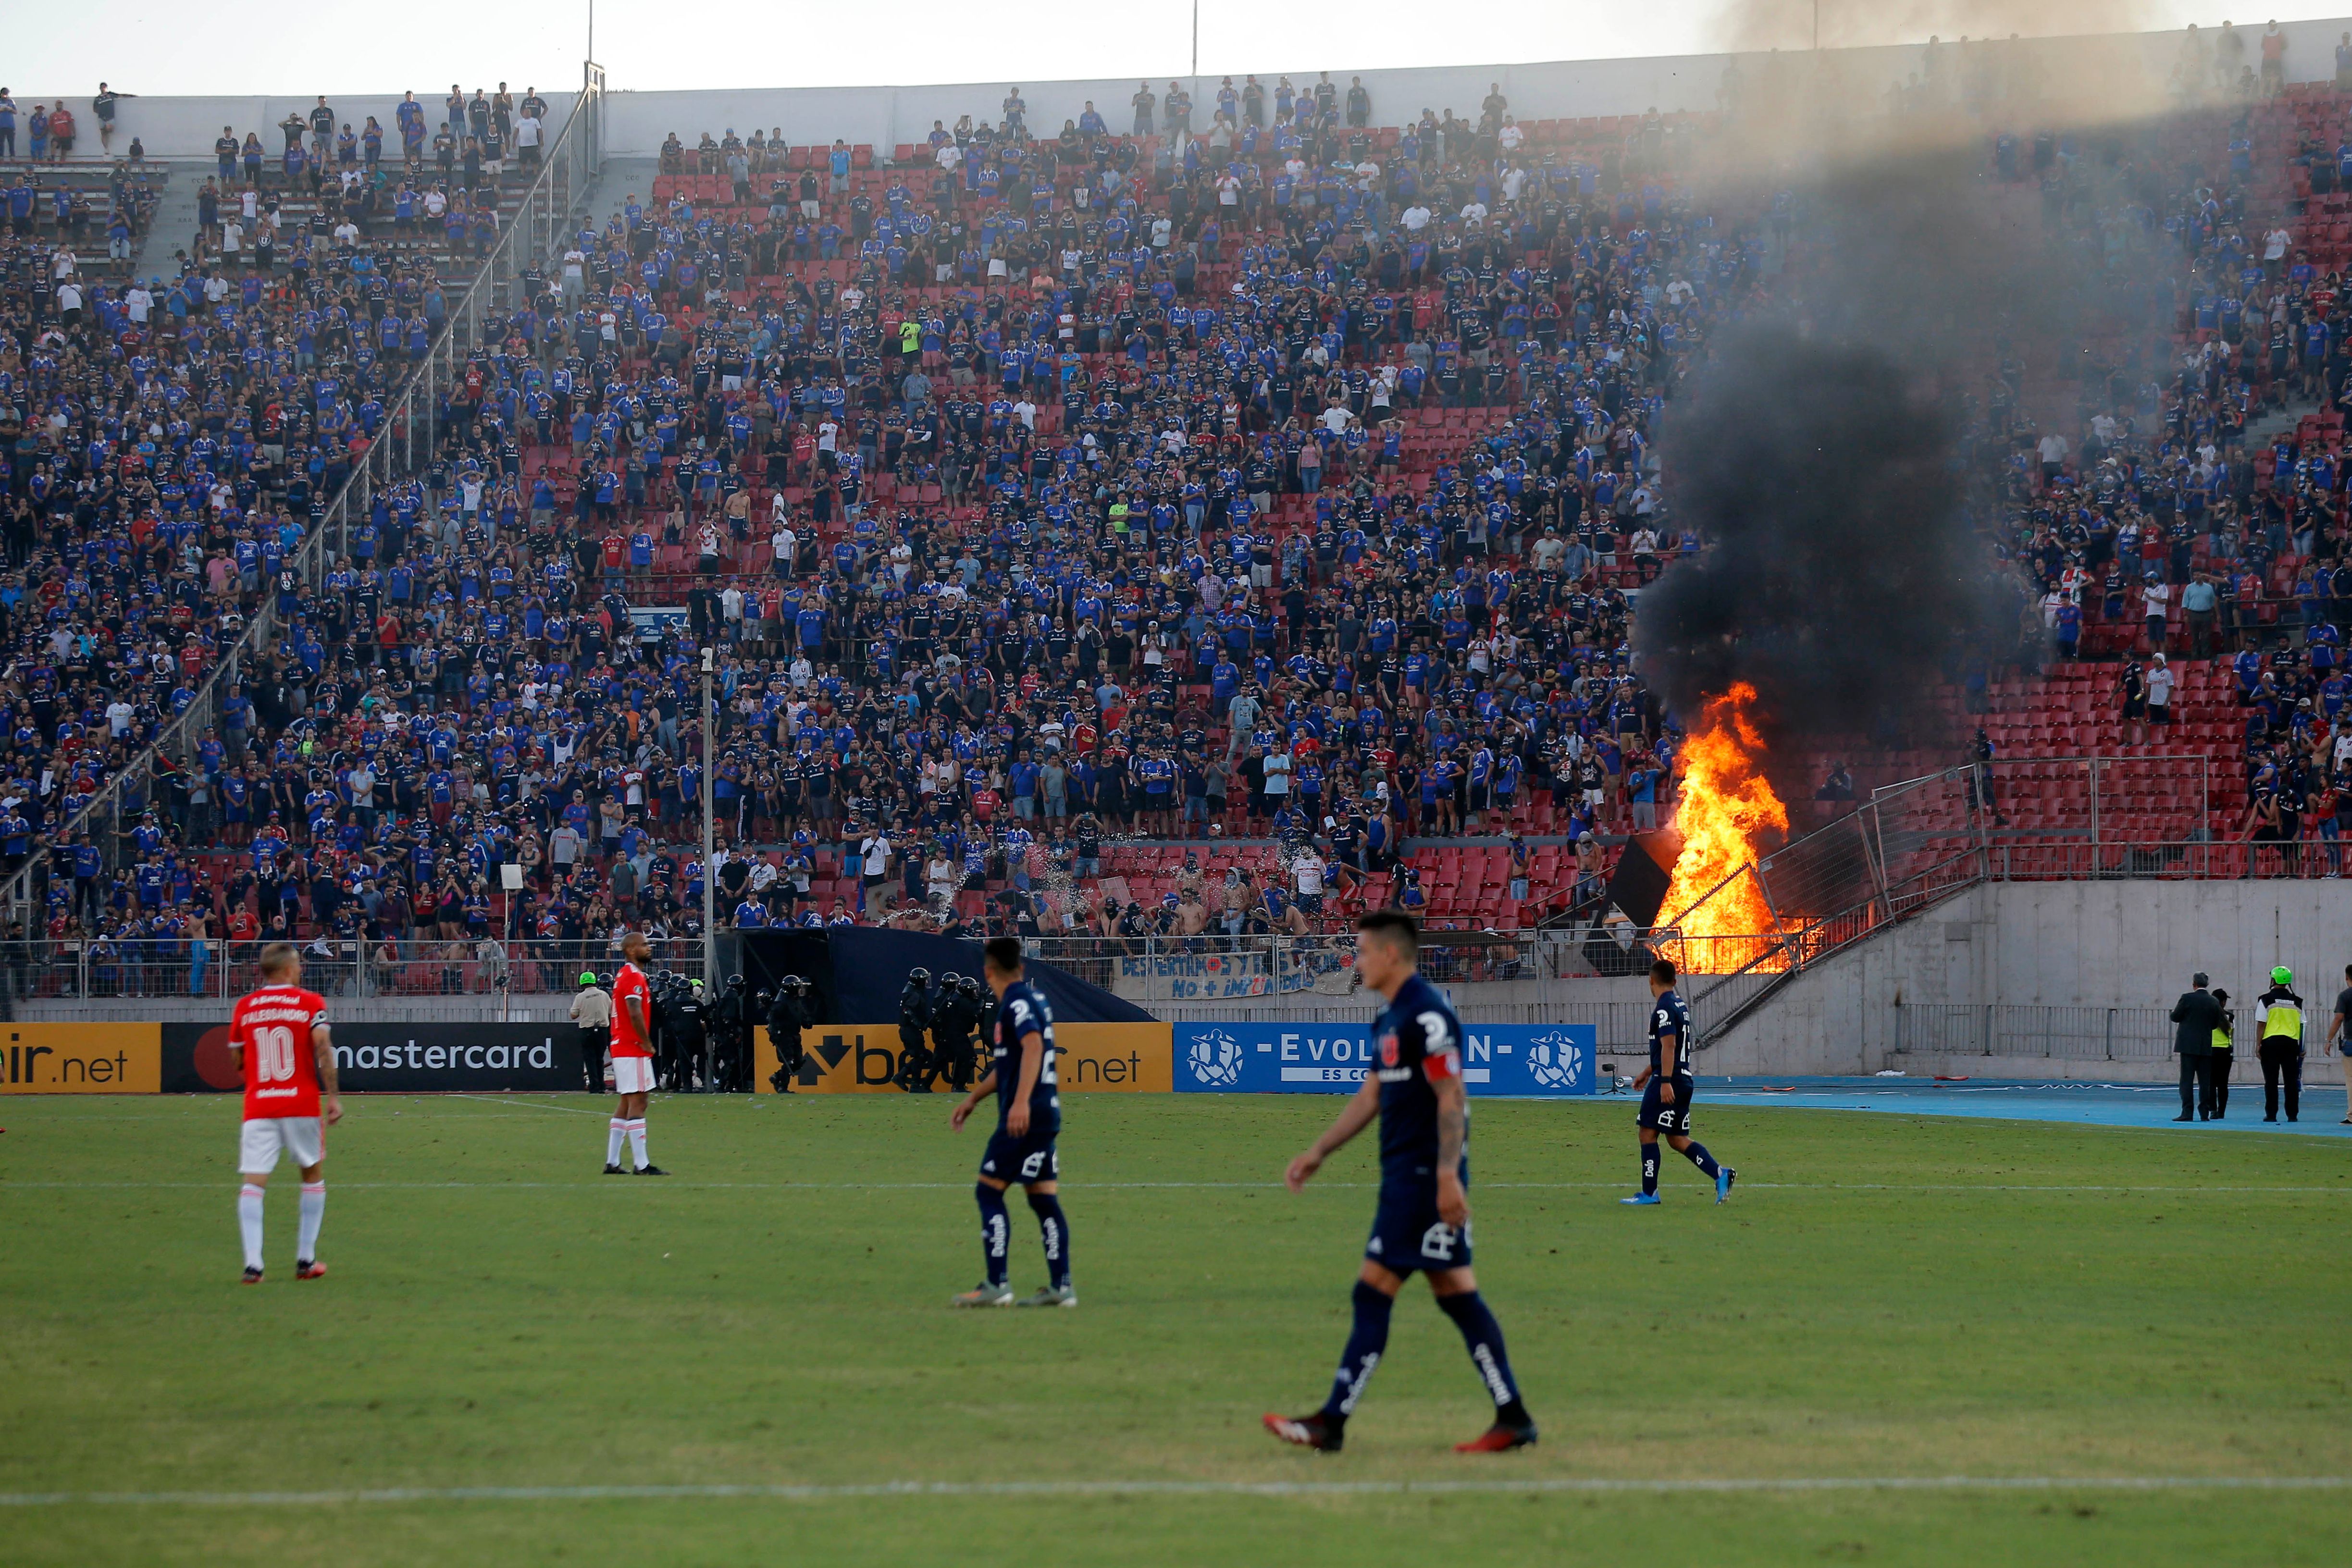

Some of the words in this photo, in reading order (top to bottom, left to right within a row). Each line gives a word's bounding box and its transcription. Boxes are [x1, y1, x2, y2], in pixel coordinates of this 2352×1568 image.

[0, 1033, 128, 1083] ir.net
[253, 1025, 296, 1083] 10
[319, 1038, 552, 1069] mastercard
[1323, 1069, 1341, 1080] ES
